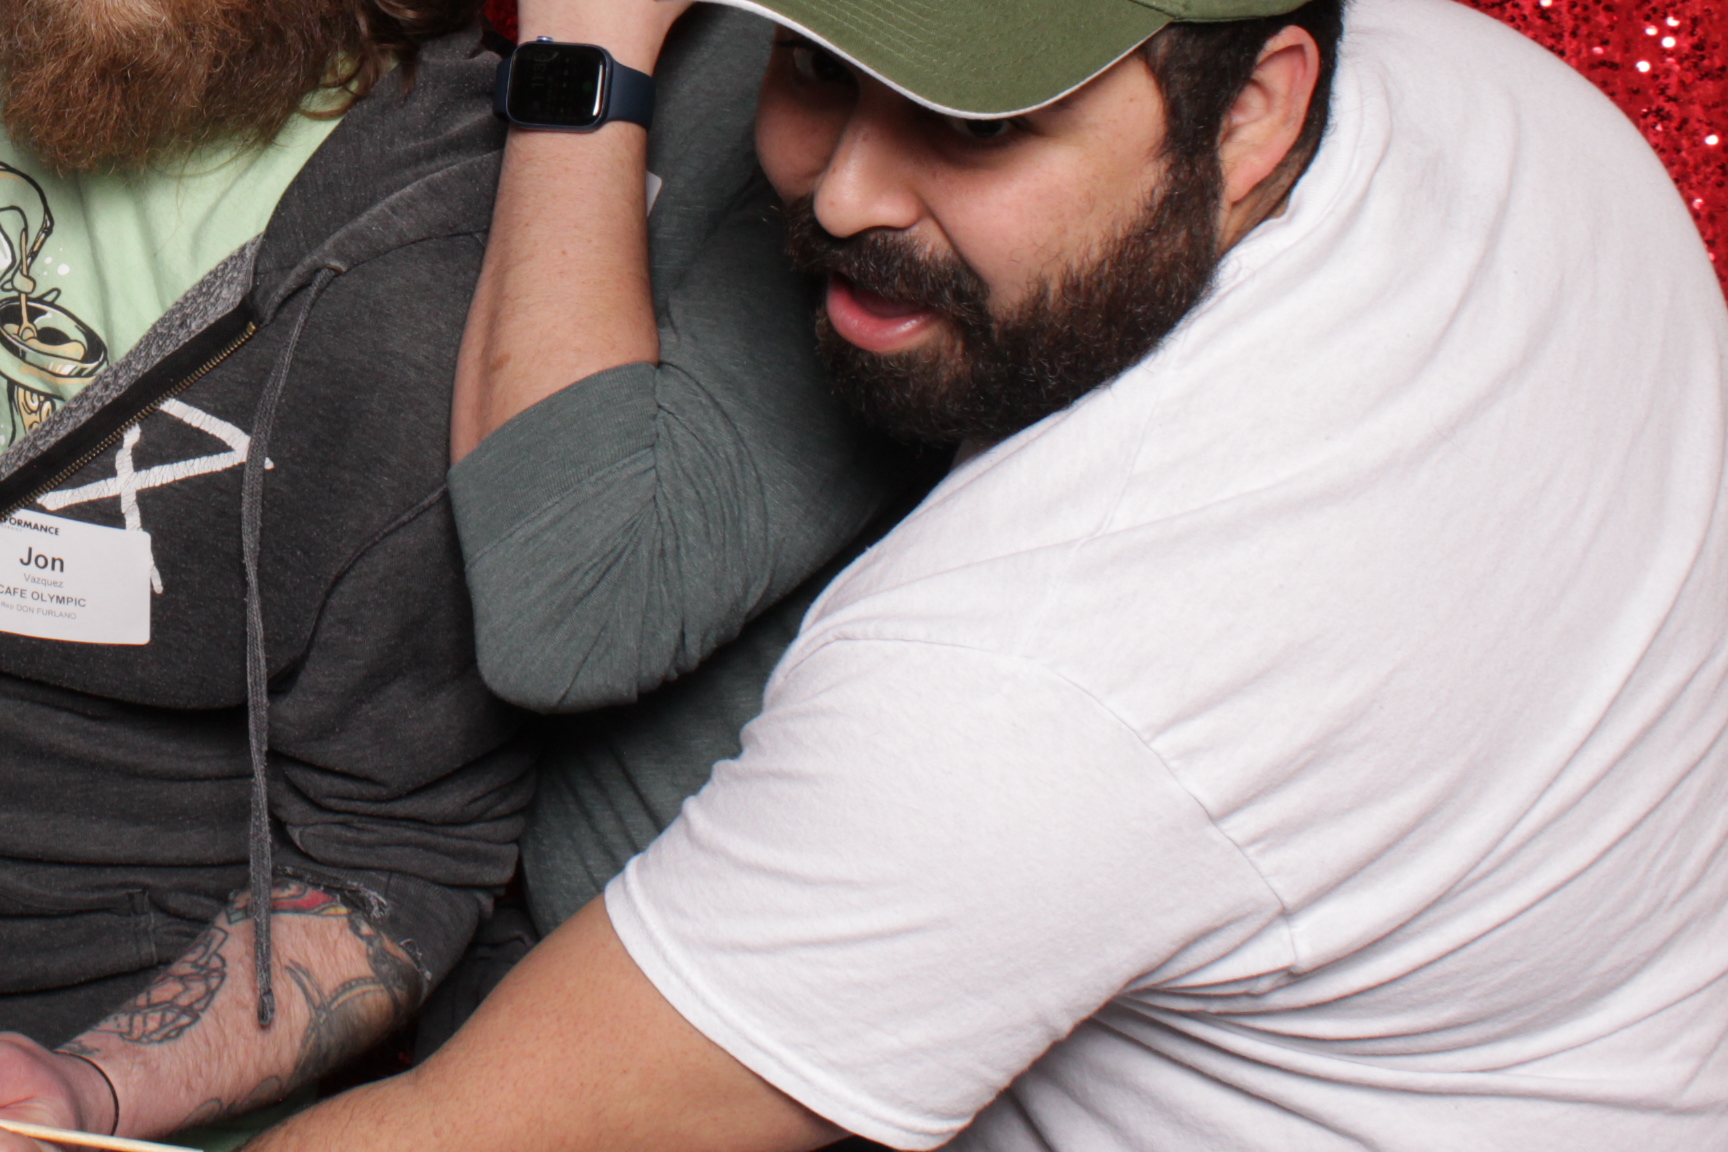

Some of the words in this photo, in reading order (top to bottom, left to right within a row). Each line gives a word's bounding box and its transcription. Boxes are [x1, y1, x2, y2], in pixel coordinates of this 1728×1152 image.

[19, 546, 65, 573] Jon
[23, 572, 64, 589] Vazquez
[31, 590, 87, 608] OLYMPIC
[16, 603, 34, 614] DON
